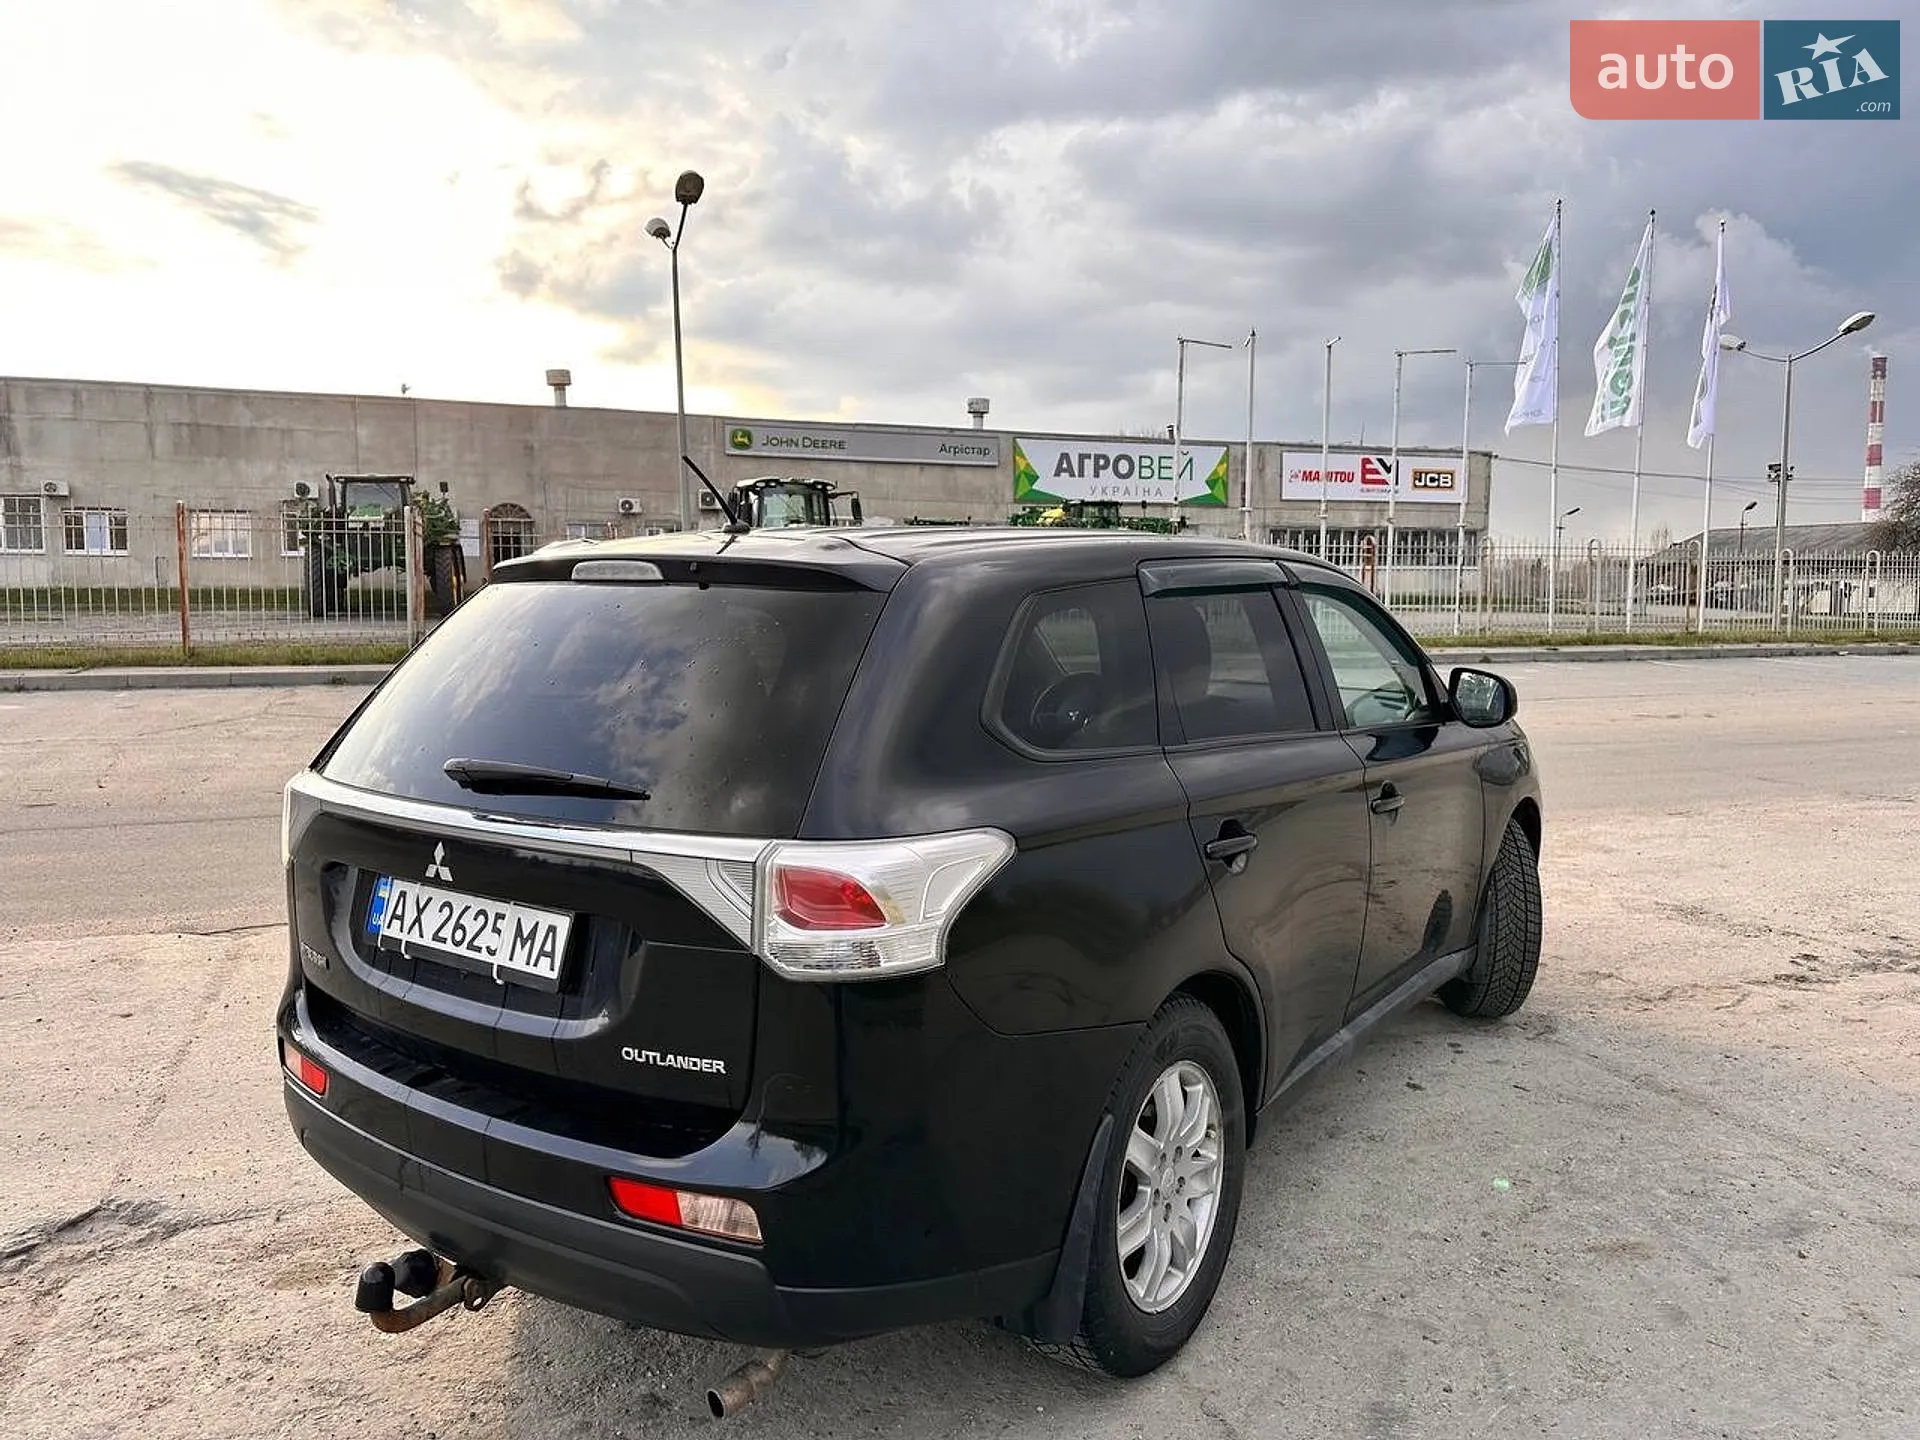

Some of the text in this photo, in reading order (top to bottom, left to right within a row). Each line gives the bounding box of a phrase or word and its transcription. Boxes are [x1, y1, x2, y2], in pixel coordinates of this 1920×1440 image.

[762, 435, 848, 450] JOHN DEERE
[1053, 450, 1194, 482] АГРОВЕЙ
[1414, 473, 1453, 487] JCB
[432, 900, 507, 957] 2625
[508, 916, 558, 973] MA
[621, 1046, 727, 1075] OUTLANDER
